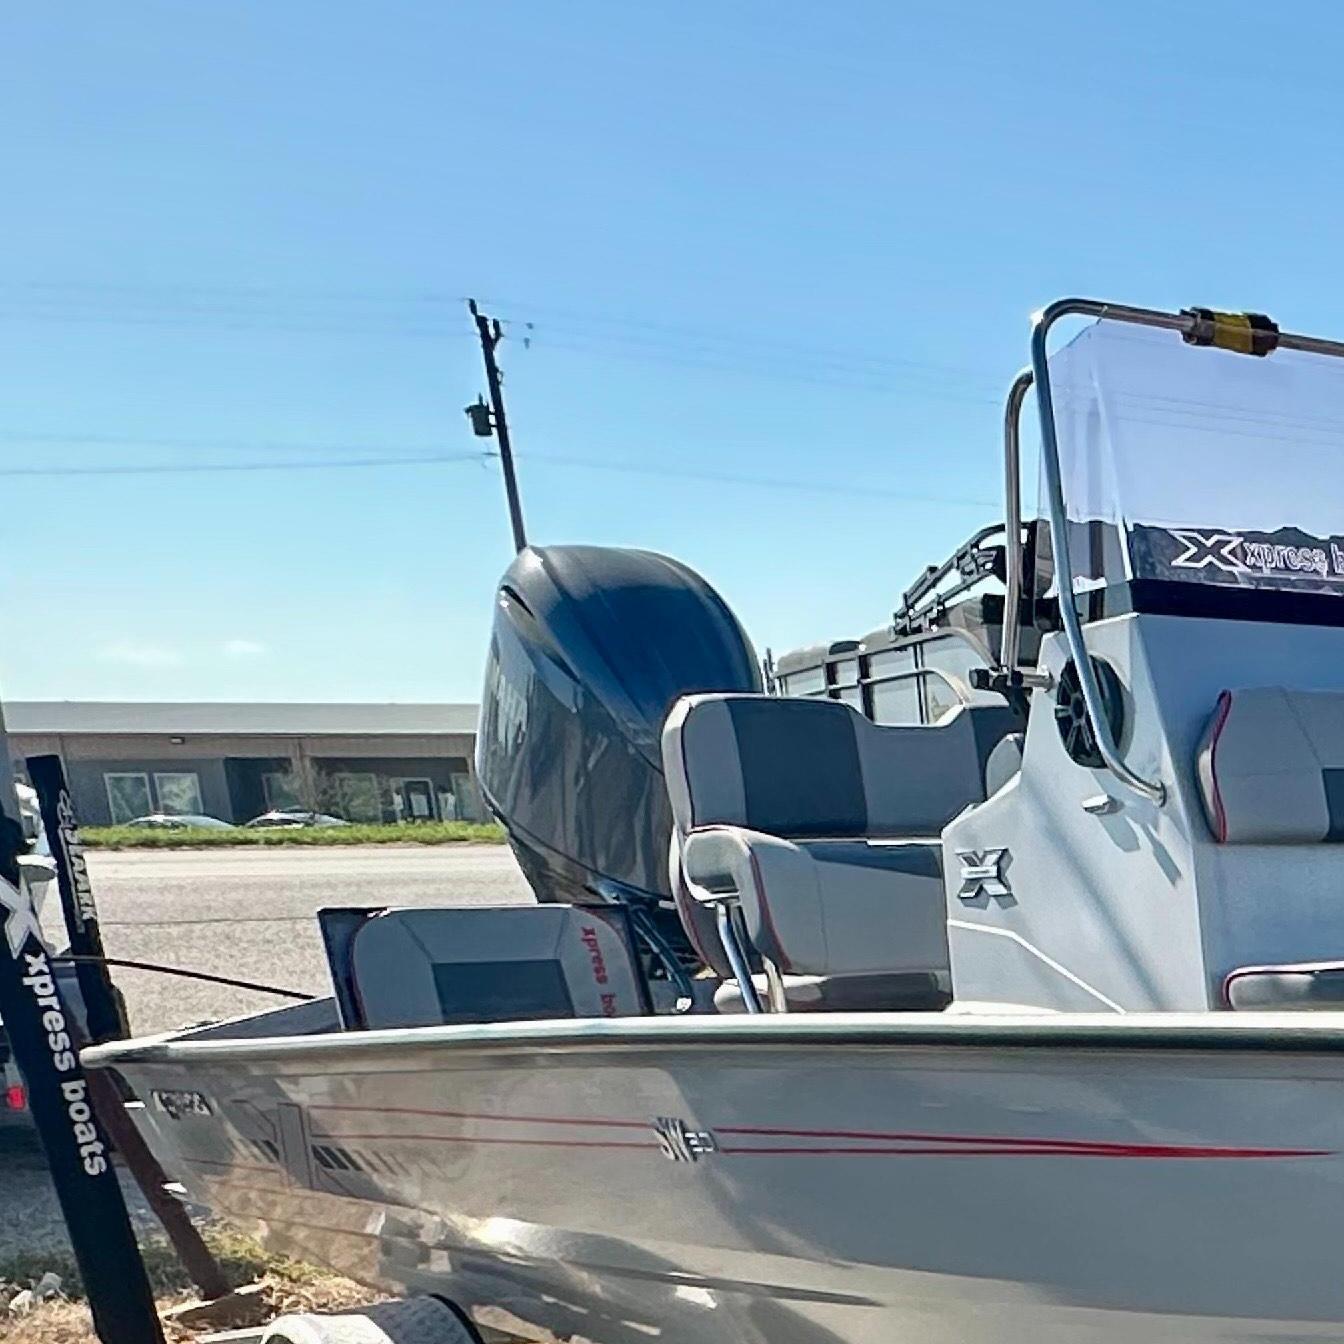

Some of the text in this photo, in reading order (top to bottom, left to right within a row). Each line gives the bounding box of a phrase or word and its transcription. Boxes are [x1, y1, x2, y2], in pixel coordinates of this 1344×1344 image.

[1243, 541, 1329, 579] xpress
[580, 926, 609, 985] xpress
[23, 950, 76, 1074] xpress
[61, 1078, 108, 1178] boats
